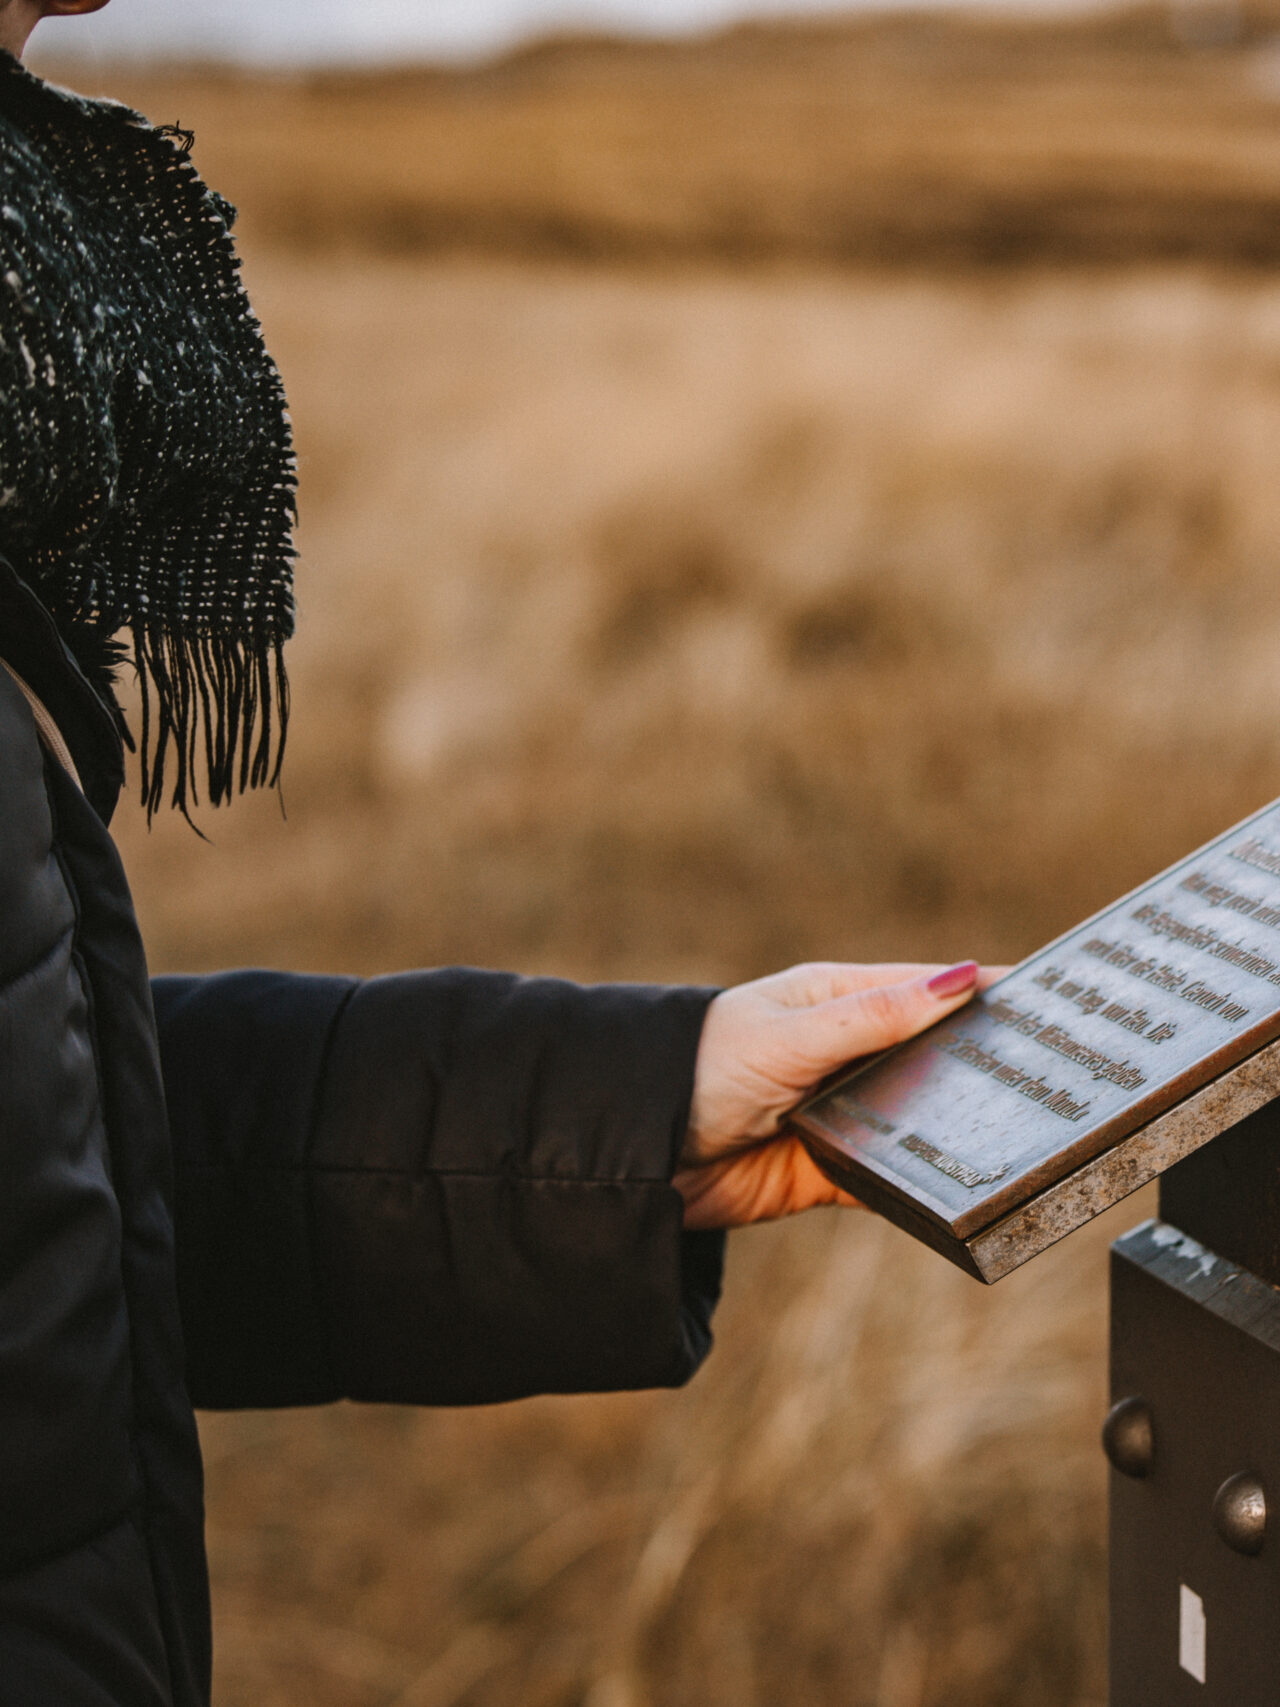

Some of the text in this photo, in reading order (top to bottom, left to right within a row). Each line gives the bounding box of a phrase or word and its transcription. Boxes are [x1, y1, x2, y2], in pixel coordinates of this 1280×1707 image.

[1224, 894, 1261, 914] noch
[1207, 941, 1277, 978] schwärmen
[1129, 958, 1156, 977] die
[1145, 965, 1185, 992] Heide.
[1177, 980, 1229, 1011] Geruch
[1215, 1002, 1249, 1022] von
[1098, 1003, 1129, 1022] von
[1118, 1009, 1151, 1035] Heu.
[1142, 1021, 1175, 1044] Die
[1033, 1024, 1109, 1071] Wattenmeeres
[990, 1064, 1029, 1089] unter
[1018, 1077, 1052, 1101] dem
[1040, 1088, 1088, 1121] Mond.«
